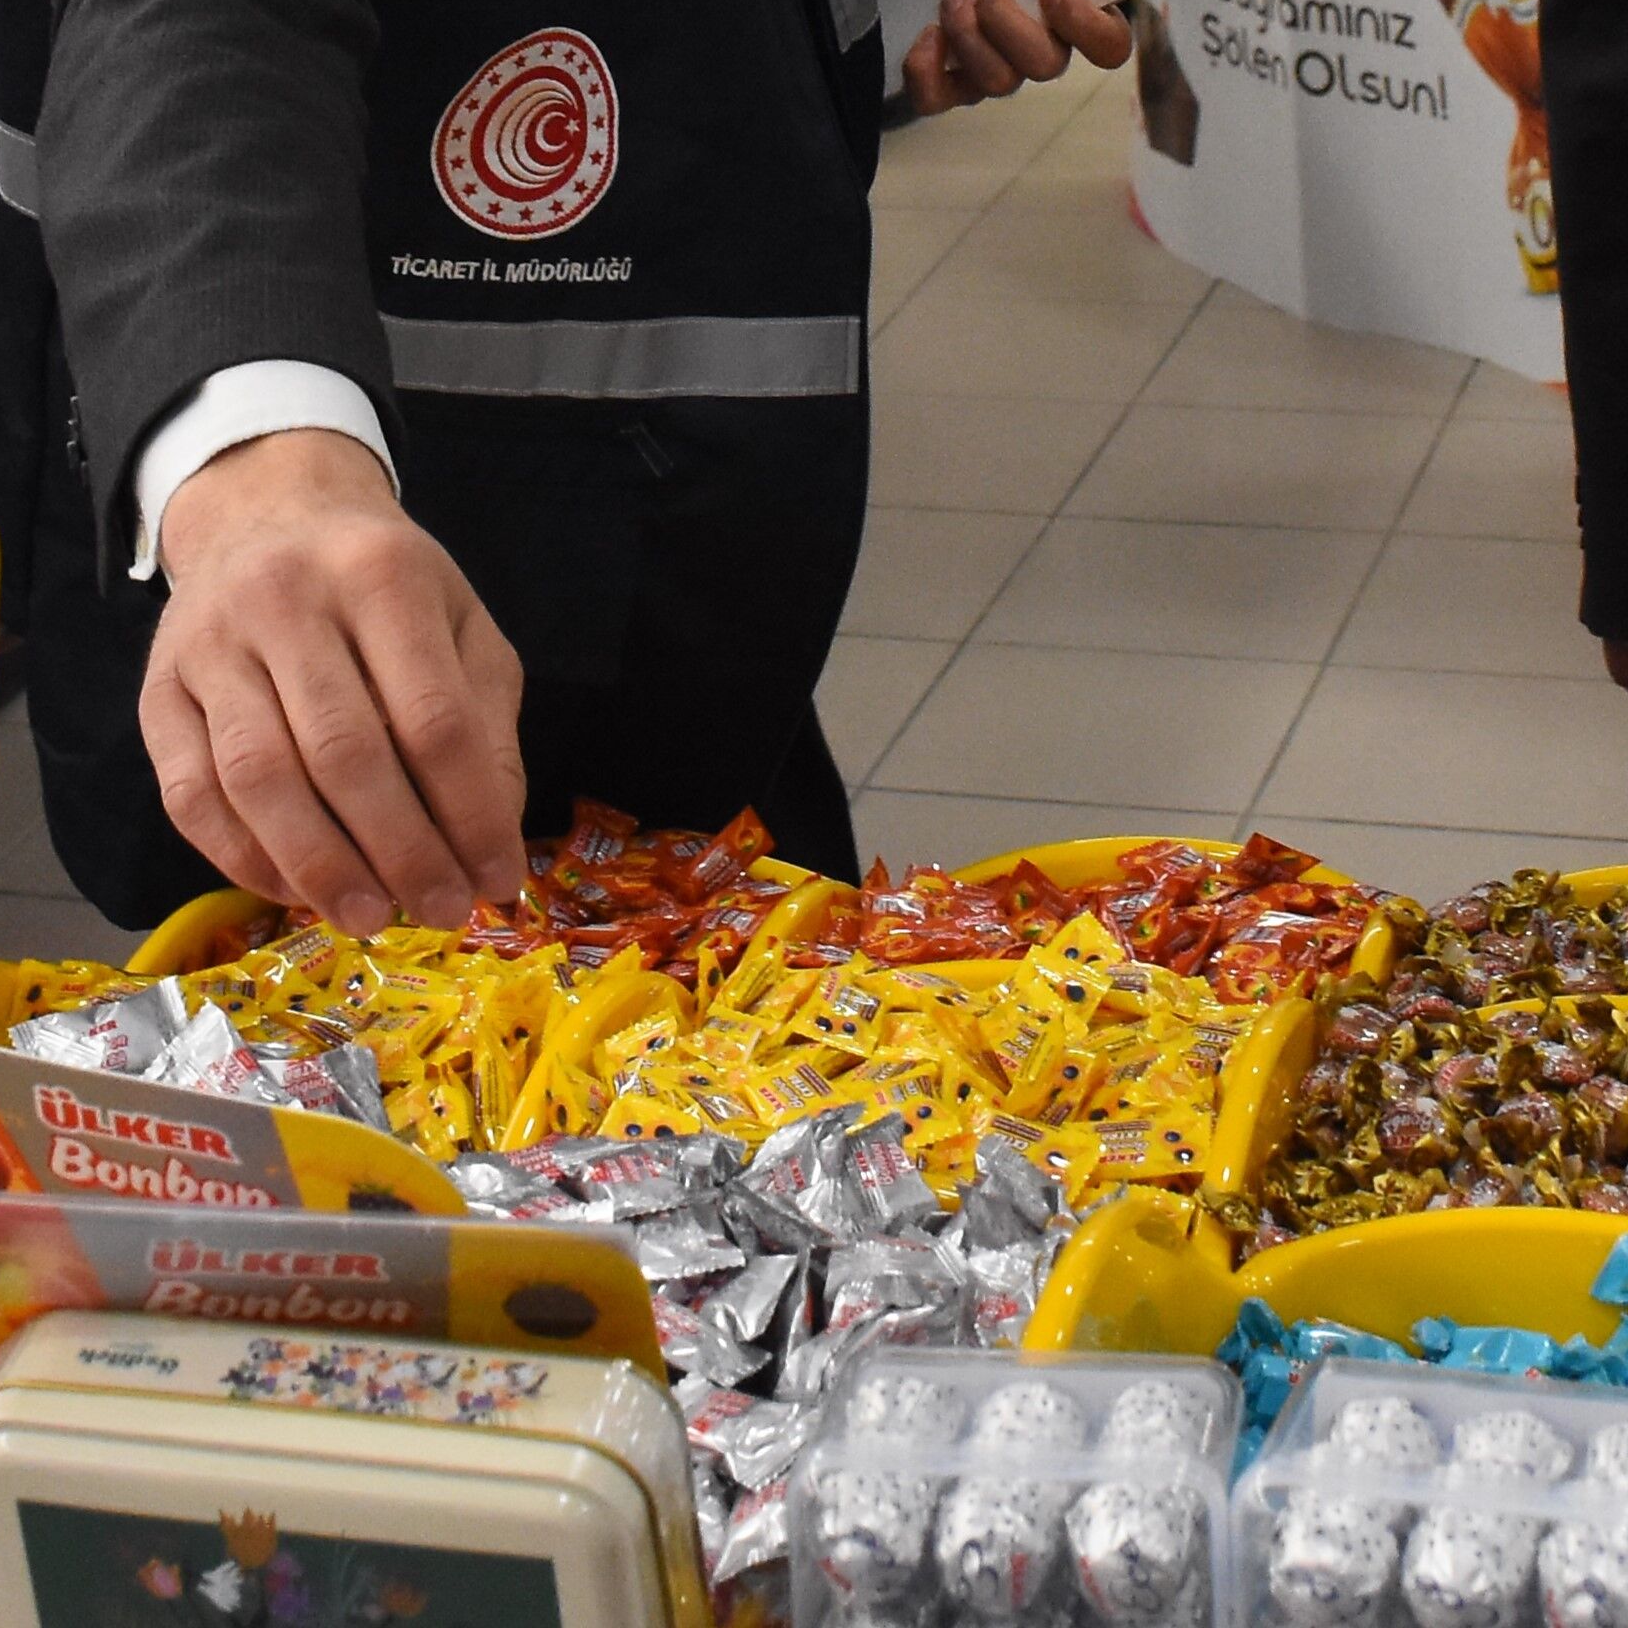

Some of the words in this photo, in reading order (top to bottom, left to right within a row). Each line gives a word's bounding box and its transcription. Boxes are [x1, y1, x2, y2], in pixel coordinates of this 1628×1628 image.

[1202, 14, 1286, 85] Şölen
[1295, 48, 1449, 121] Olsun!
[391, 253, 479, 281] TİCARET
[482, 257, 501, 281] İL
[504, 257, 632, 284] MÜDÜRLÜĞÜ
[34, 1084, 242, 1165] ÜLKER
[51, 1133, 280, 1208] Bonbon
[149, 1239, 390, 1282] ÜLKER
[145, 1278, 413, 1325] Bonbon
